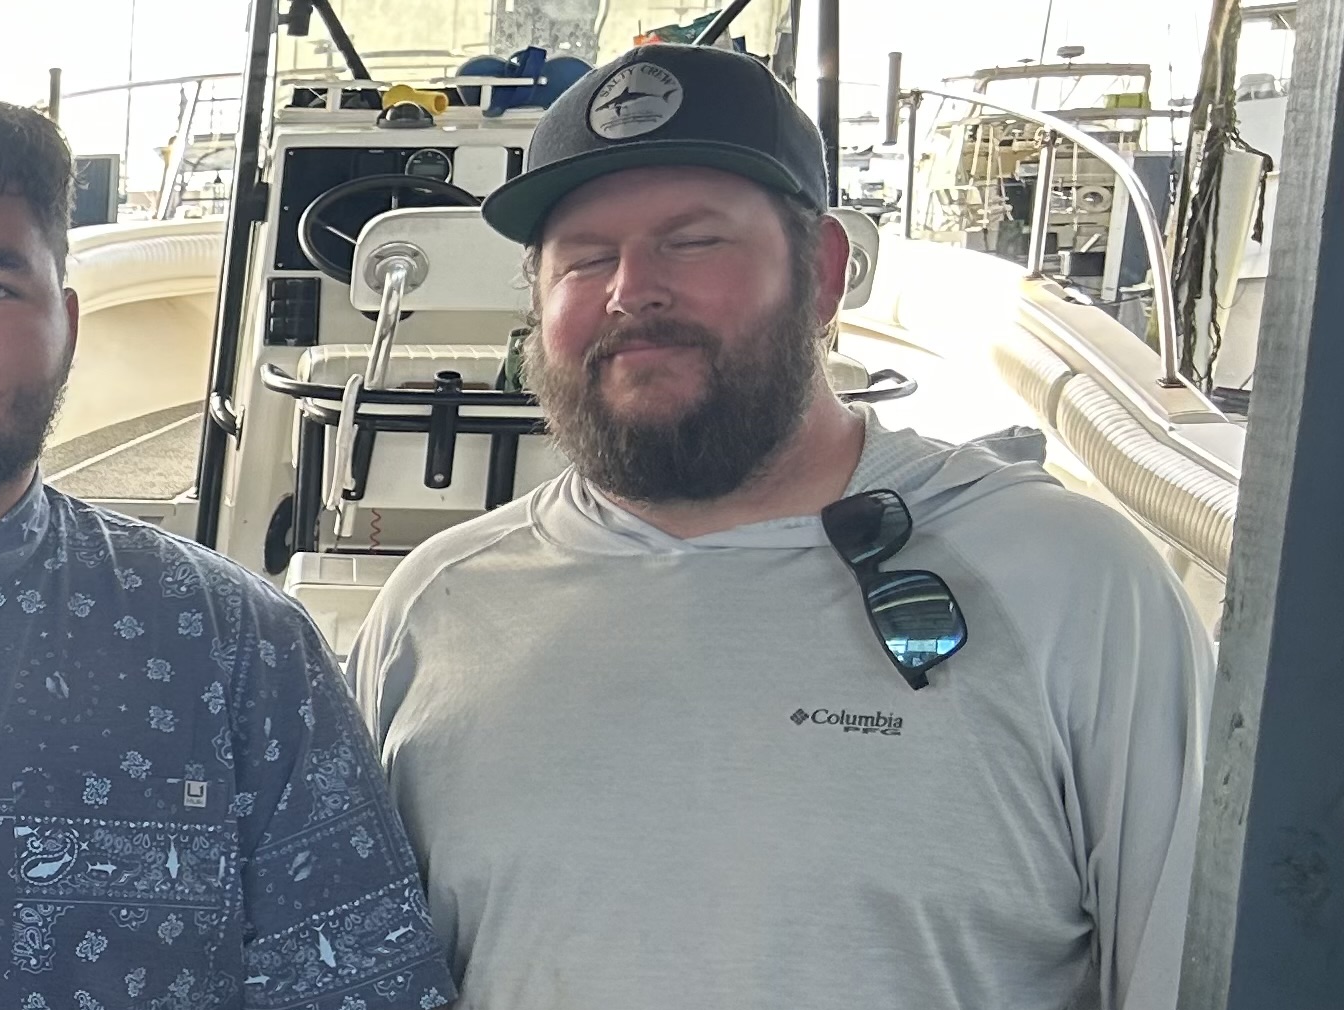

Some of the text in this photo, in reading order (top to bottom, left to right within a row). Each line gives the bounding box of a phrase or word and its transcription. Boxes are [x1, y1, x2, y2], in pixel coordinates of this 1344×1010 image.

[599, 64, 676, 98] SALTY CREW
[810, 708, 903, 728] Columbia
[843, 726, 901, 735] PFG
